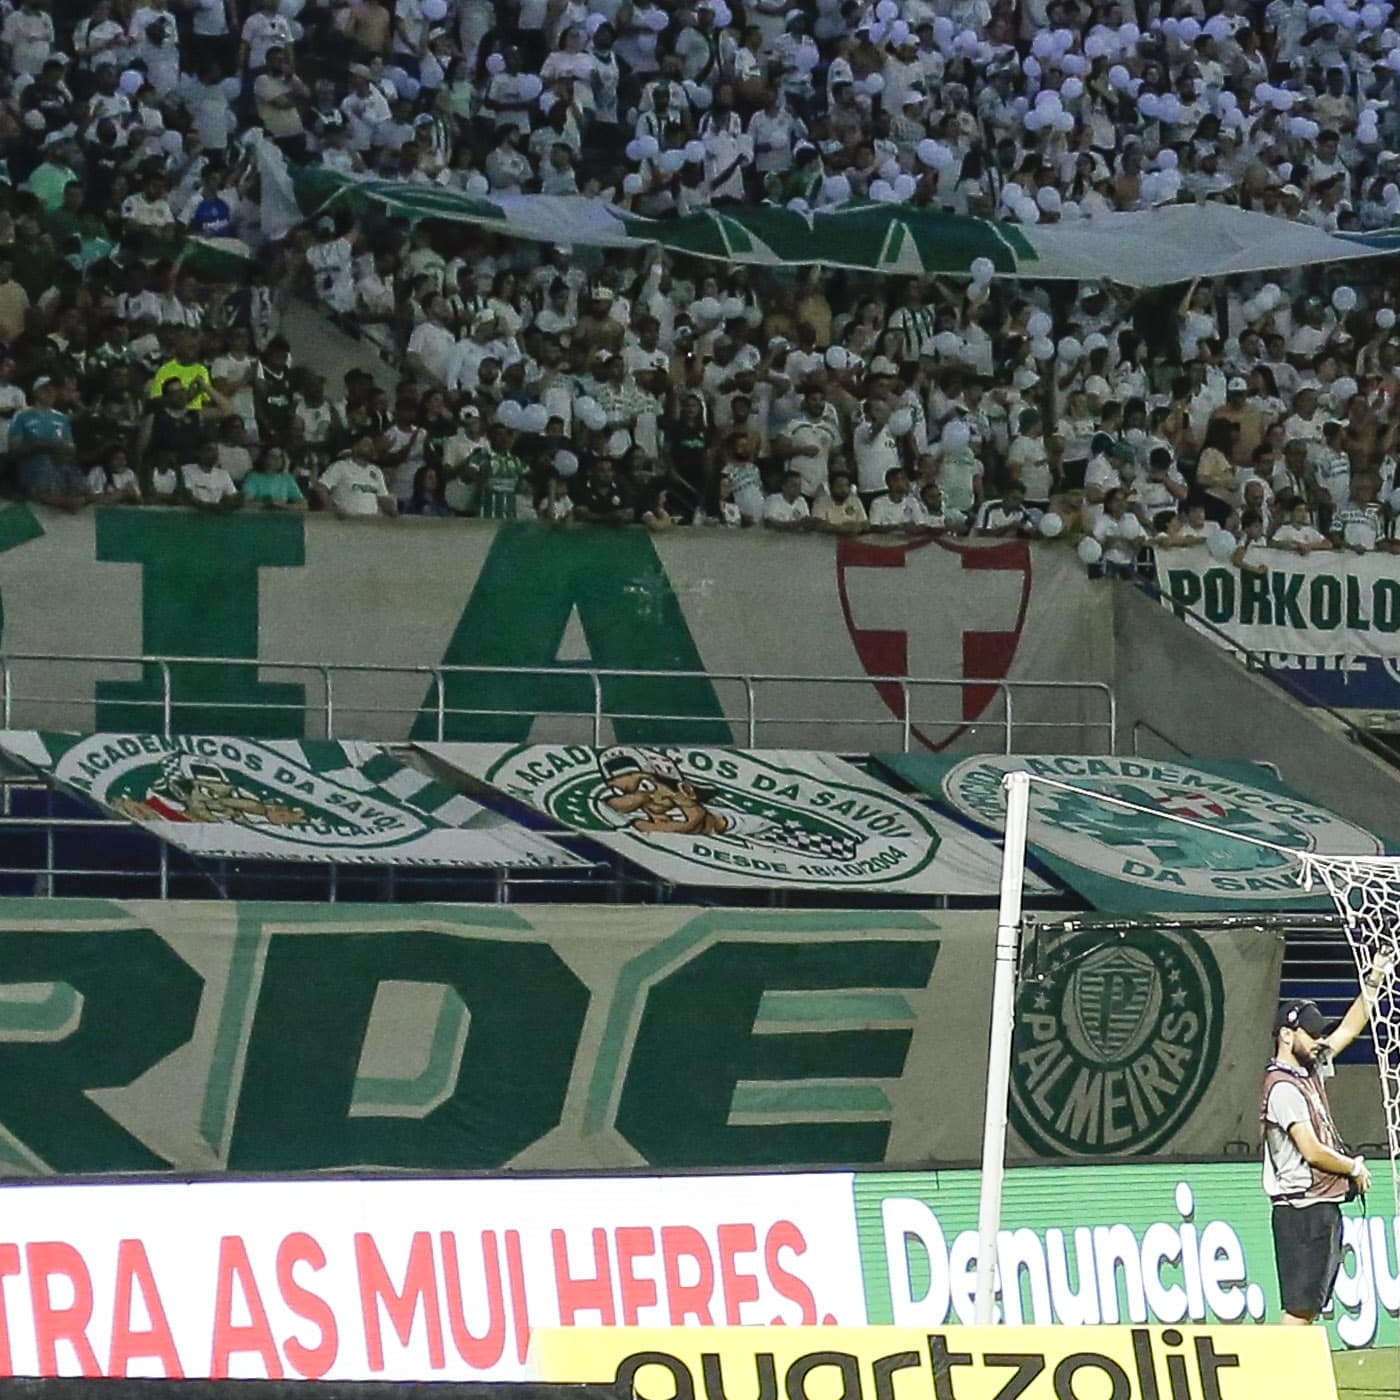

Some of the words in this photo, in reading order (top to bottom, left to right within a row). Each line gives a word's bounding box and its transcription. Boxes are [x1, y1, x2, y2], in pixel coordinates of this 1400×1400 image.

[95, 507, 734, 744] IA
[273, 767, 317, 796] DA
[515, 746, 740, 790] ACADCOS
[752, 773, 800, 801] DA
[1024, 757, 1333, 827] ACADEMICOS
[692, 843, 791, 875] DESDE
[798, 845, 908, 878] 18/10/2004
[1121, 858, 1187, 887] DA
[1017, 1010, 1199, 1145] PALMEIRAS
[881, 1181, 1266, 1327] Denuncie.
[211, 1232, 340, 1380] AS
